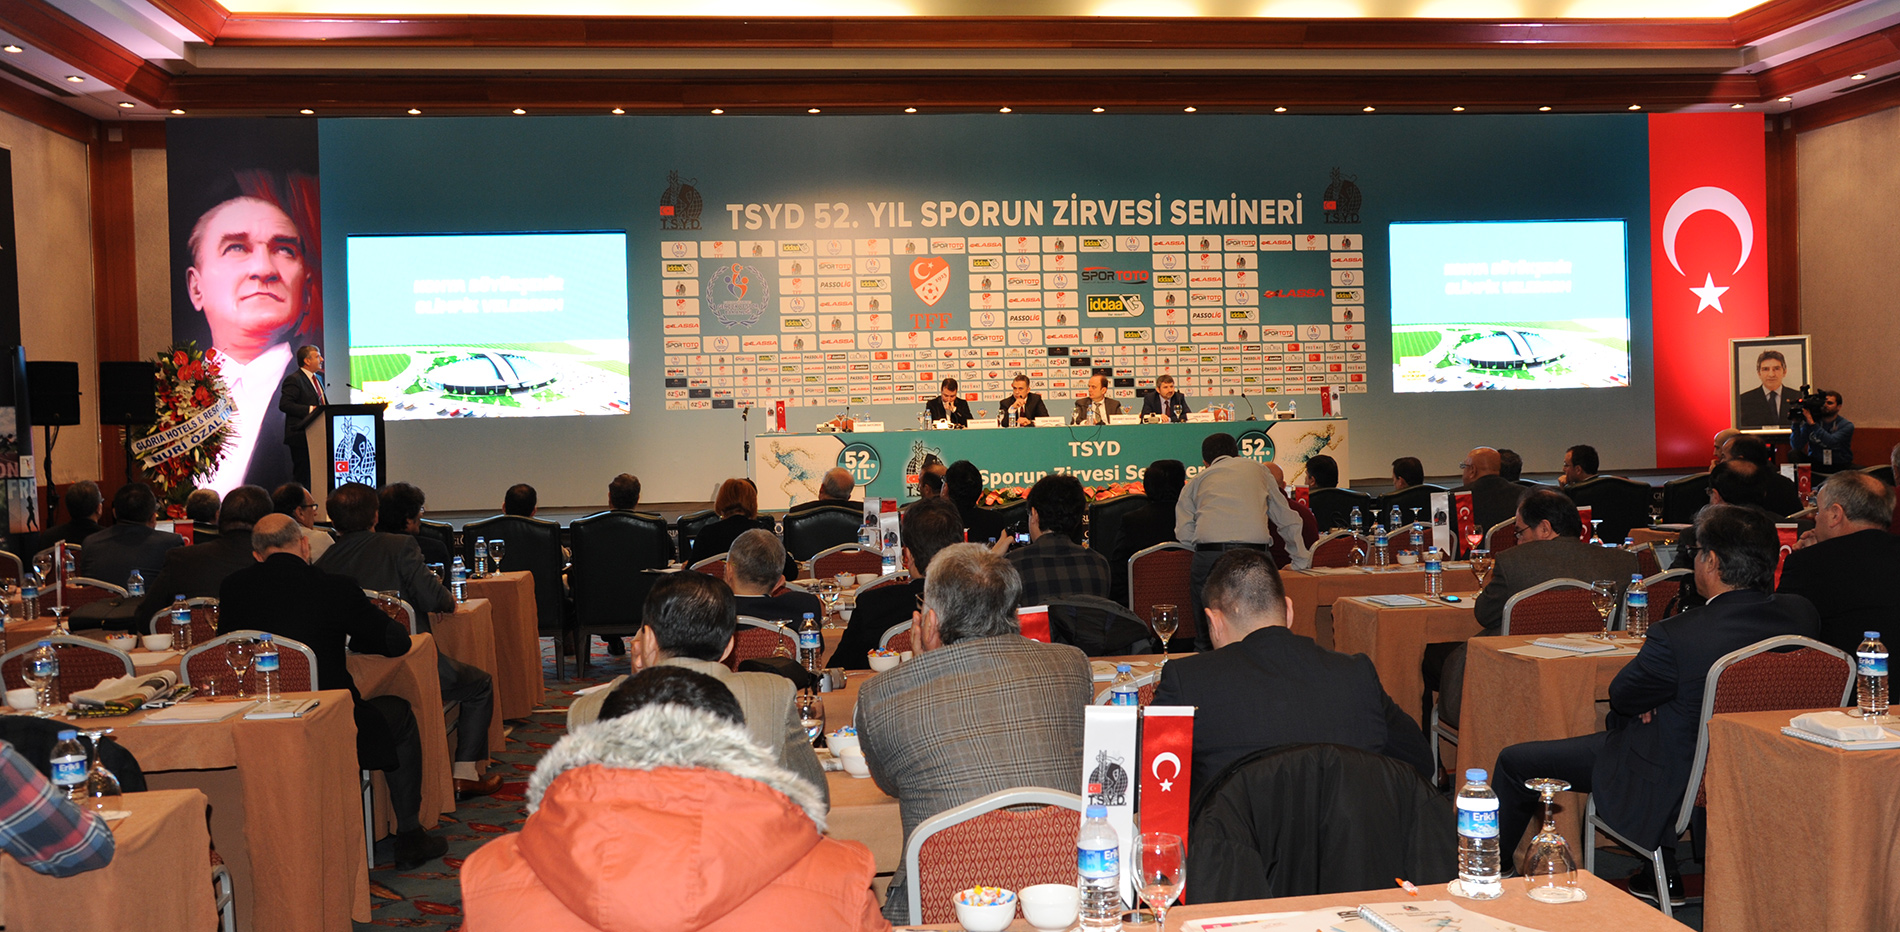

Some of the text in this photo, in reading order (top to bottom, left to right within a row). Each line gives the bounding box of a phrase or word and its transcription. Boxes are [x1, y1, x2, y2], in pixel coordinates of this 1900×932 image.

[726, 192, 1303, 230] TSYD 52. YIL SPORUN ZİRVESİ SEMİNERİ
[1082, 270, 1149, 280] SPORTOTO
[1278, 289, 1325, 298] LASSA
[1090, 298, 1124, 310] iddaa
[909, 313, 952, 329] TFF
[136, 435, 166, 450] GLORIA
[165, 420, 197, 440] HOTELS
[152, 405, 233, 463] NURİ ÖZALTIN
[1068, 440, 1121, 457] TSYD
[1242, 438, 1270, 456] 52.
[844, 450, 876, 470] 52.
[848, 469, 872, 480] YIL
[980, 469, 1048, 488] Sporun
[1088, 794, 1127, 806] T.S.Y.D.
